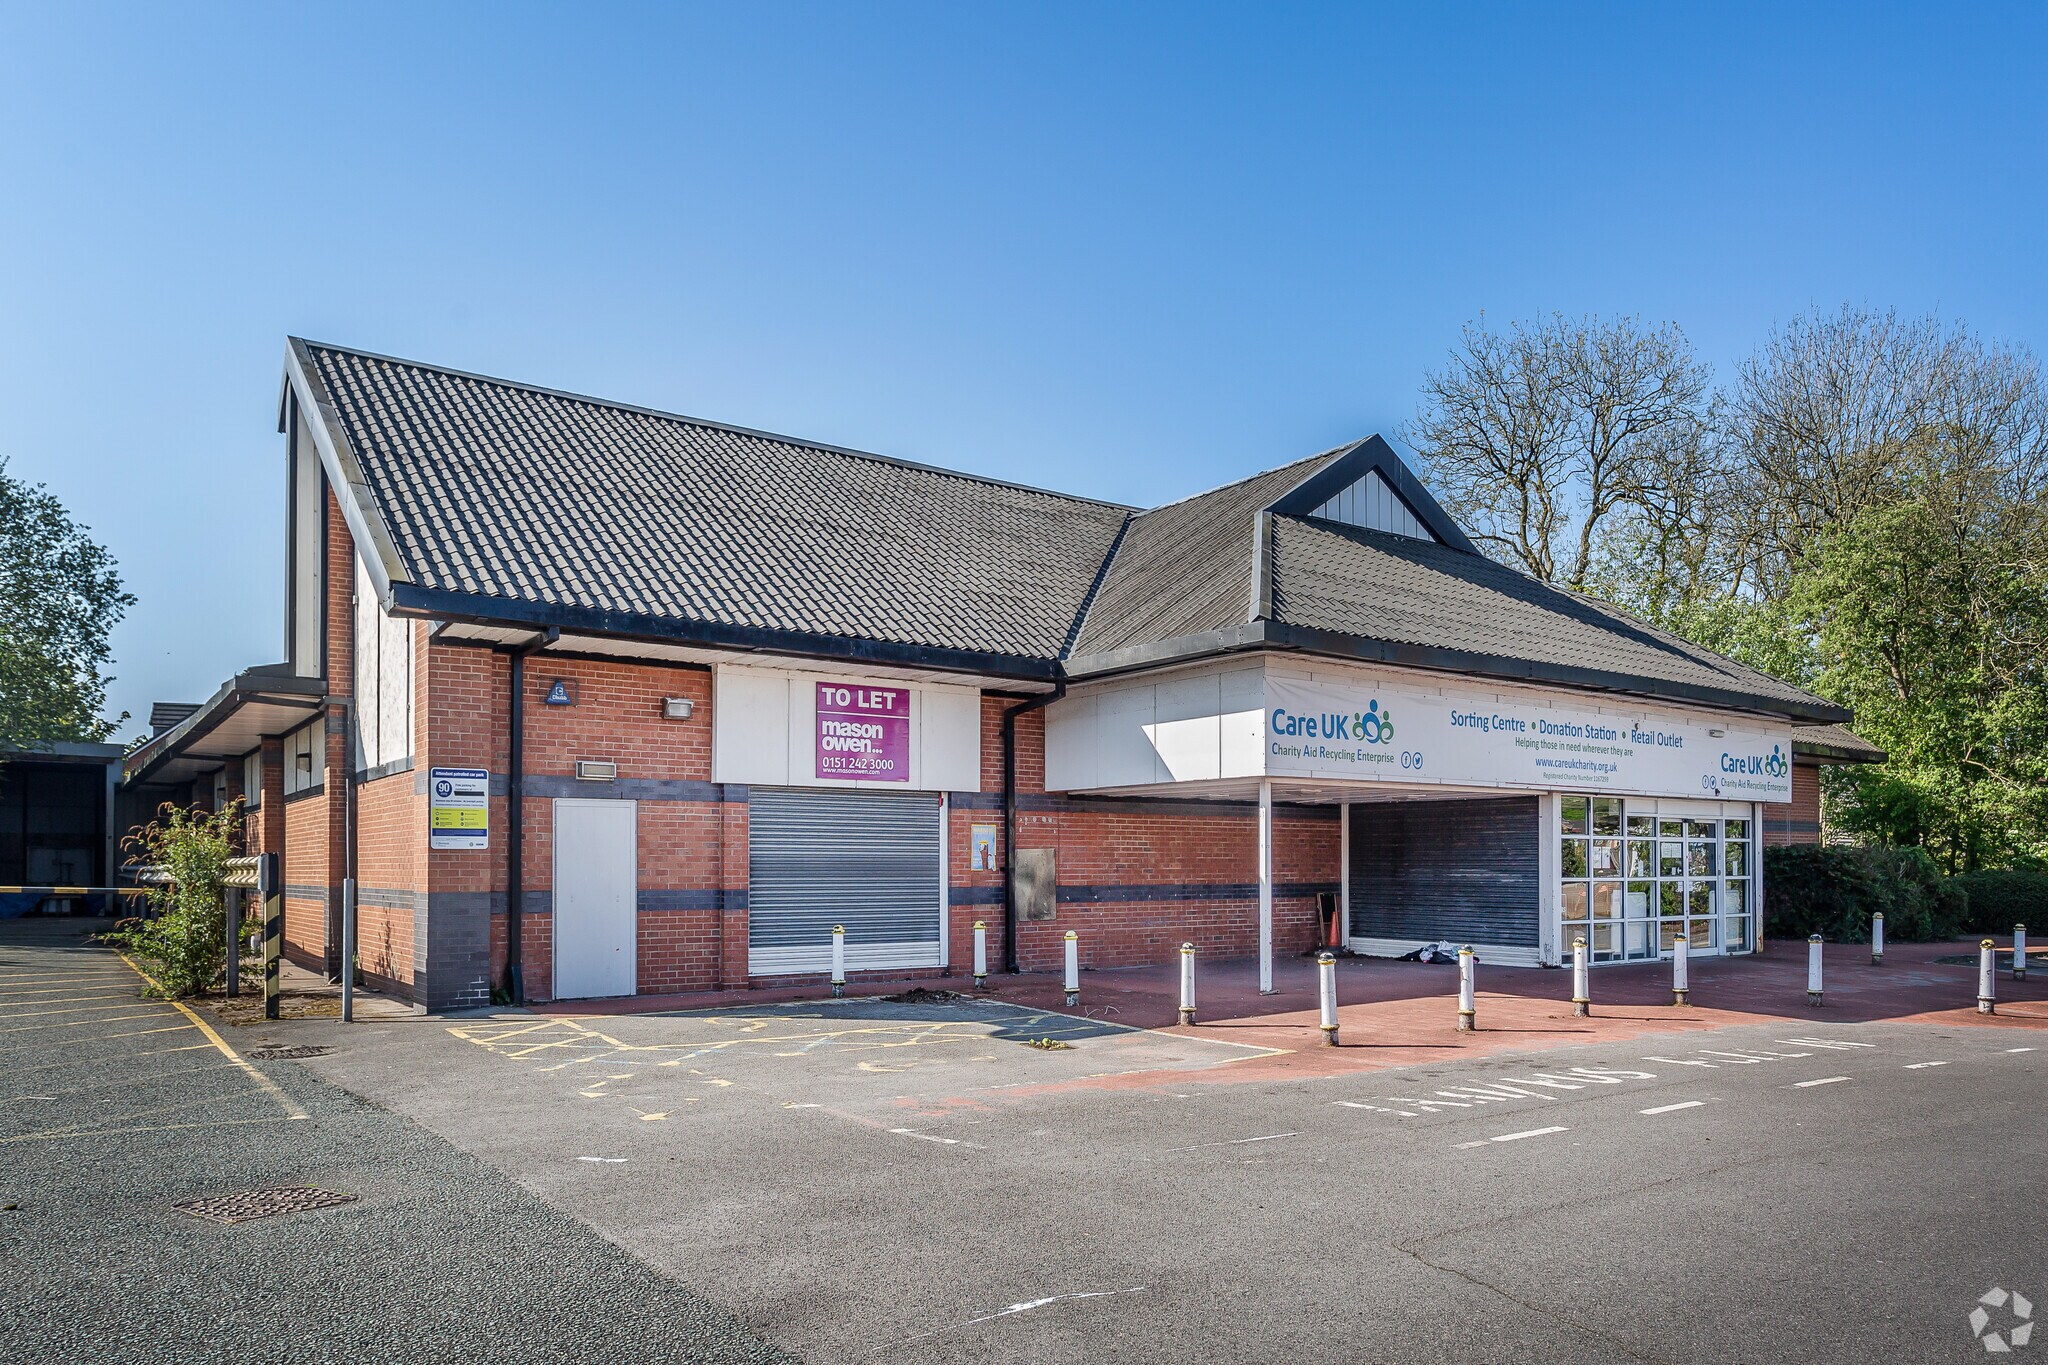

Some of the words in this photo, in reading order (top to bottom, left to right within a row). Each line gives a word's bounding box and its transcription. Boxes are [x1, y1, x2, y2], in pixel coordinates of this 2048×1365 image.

[821, 687, 851, 707] TO
[858, 690, 897, 710] LET
[821, 720, 884, 739] mason
[1272, 709, 1317, 738] Care
[1321, 713, 1349, 740] UK
[1451, 710, 1489, 733] Sorting
[1492, 714, 1526, 732] Centre
[1540, 719, 1583, 738] Donation
[1585, 724, 1617, 741] Station
[1631, 729, 1655, 745] Retail
[1657, 732, 1683, 748] Outlet
[1272, 742, 1301, 759] Charity
[1303, 745, 1318, 758] Aid
[1319, 746, 1355, 762] Recycling
[1357, 749, 1395, 764] Enterprise
[1515, 737, 1539, 751] Helping
[1540, 739, 1558, 750] those
[1559, 740, 1565, 751] in
[1566, 742, 1581, 752] need
[1582, 743, 1610, 755] wherever
[1610, 745, 1623, 758] they
[1623, 748, 1633, 757] are
[822, 756, 846, 768] 0151
[849, 757, 867, 769] 242
[869, 758, 894, 770] 3000
[1535, 758, 1618, 774] www.careukcharity.org.uk
[1721, 752, 1746, 774] Care
[1747, 755, 1763, 775] UK
[438, 782, 450, 792] 90
[1543, 772, 1564, 781] Registered
[1564, 773, 1577, 782] Charity
[1721, 777, 1737, 789] Charity
[1738, 779, 1747, 787] Aid
[1747, 780, 1767, 792] Recycling
[1767, 781, 1788, 793] Enterprise
